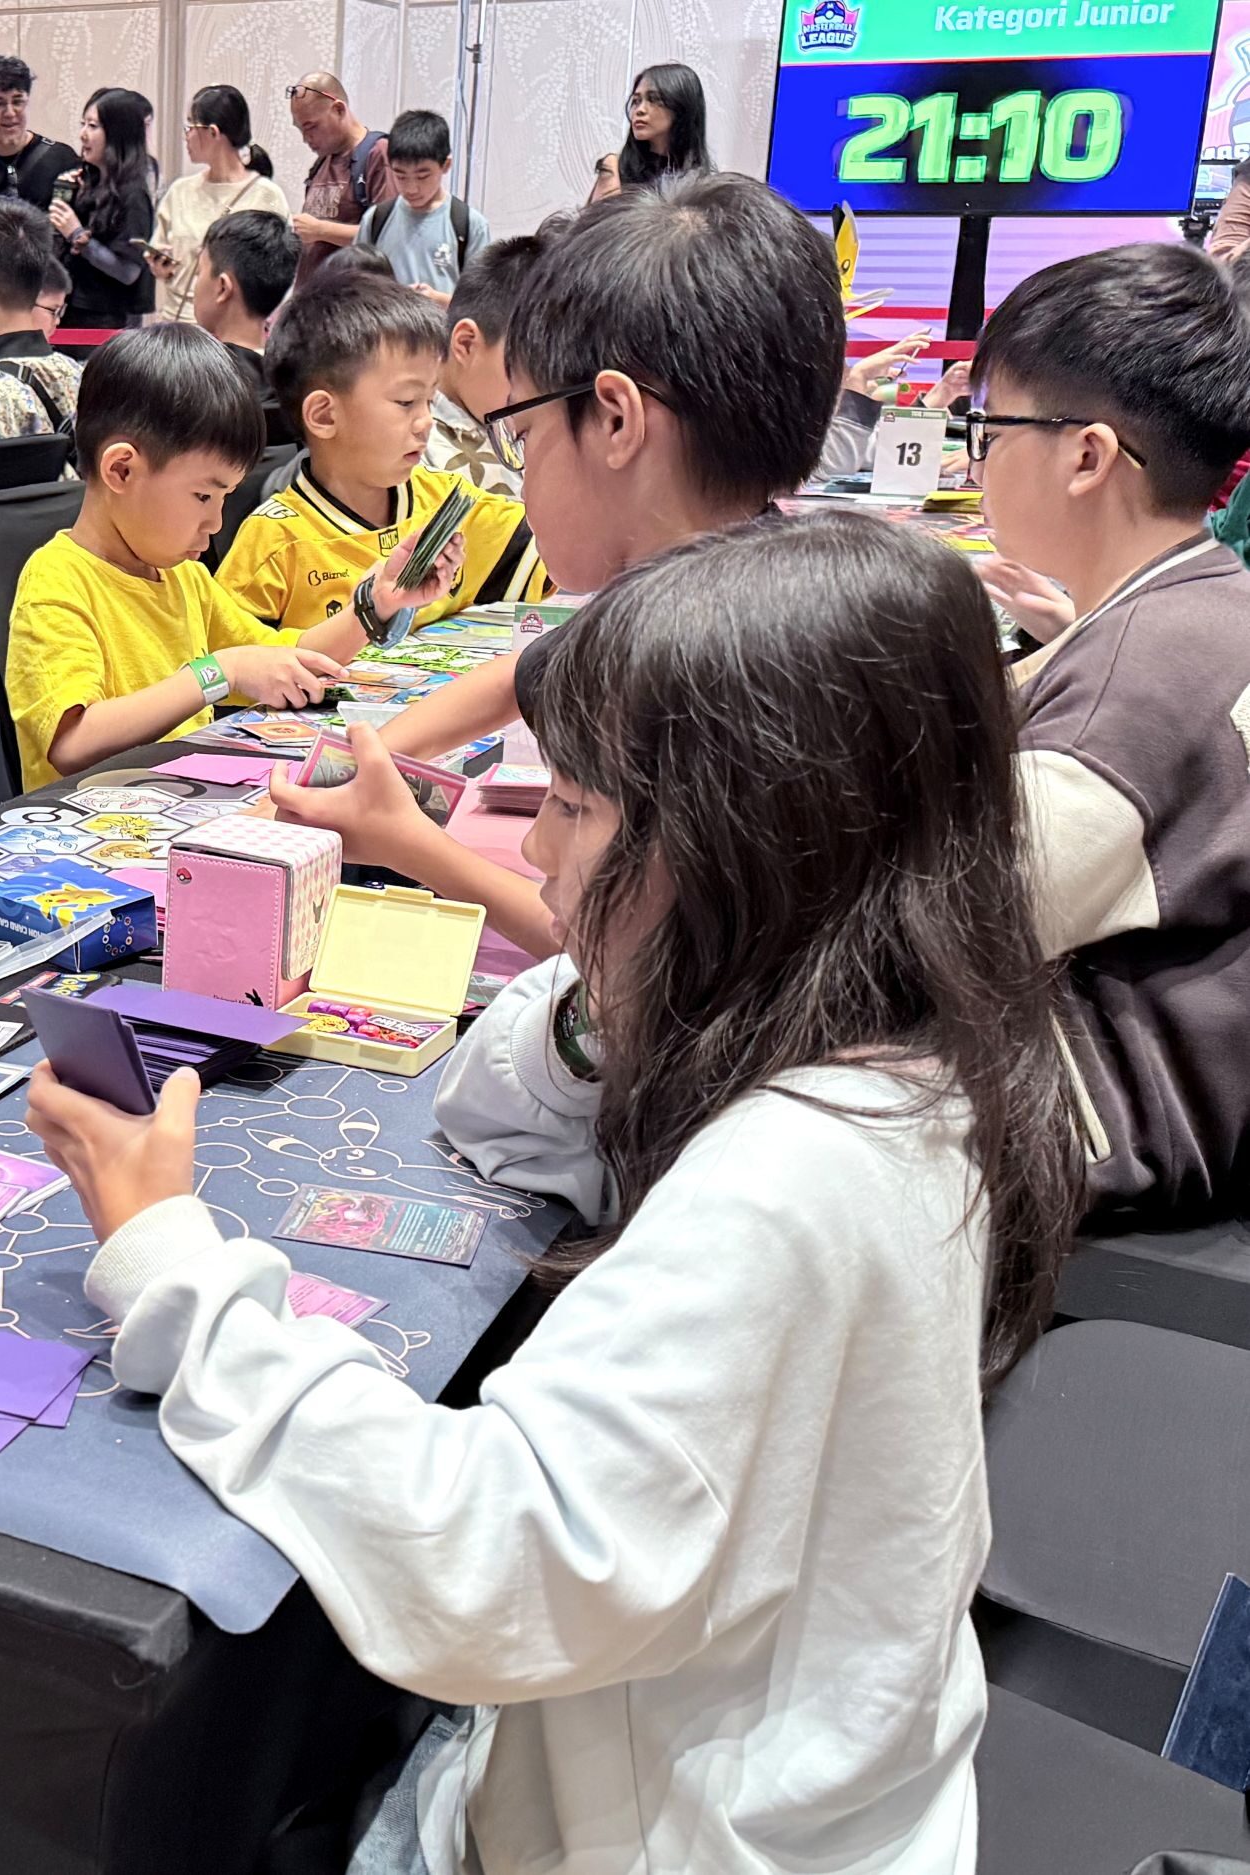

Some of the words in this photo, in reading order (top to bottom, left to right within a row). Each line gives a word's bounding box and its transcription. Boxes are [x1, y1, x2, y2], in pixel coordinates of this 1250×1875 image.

[934, 0, 1066, 35] Kategori
[1074, 0, 1174, 27] Junior
[801, 31, 855, 46] LEAGUE
[839, 89, 1123, 183] 21:10
[896, 442, 923, 467] 13
